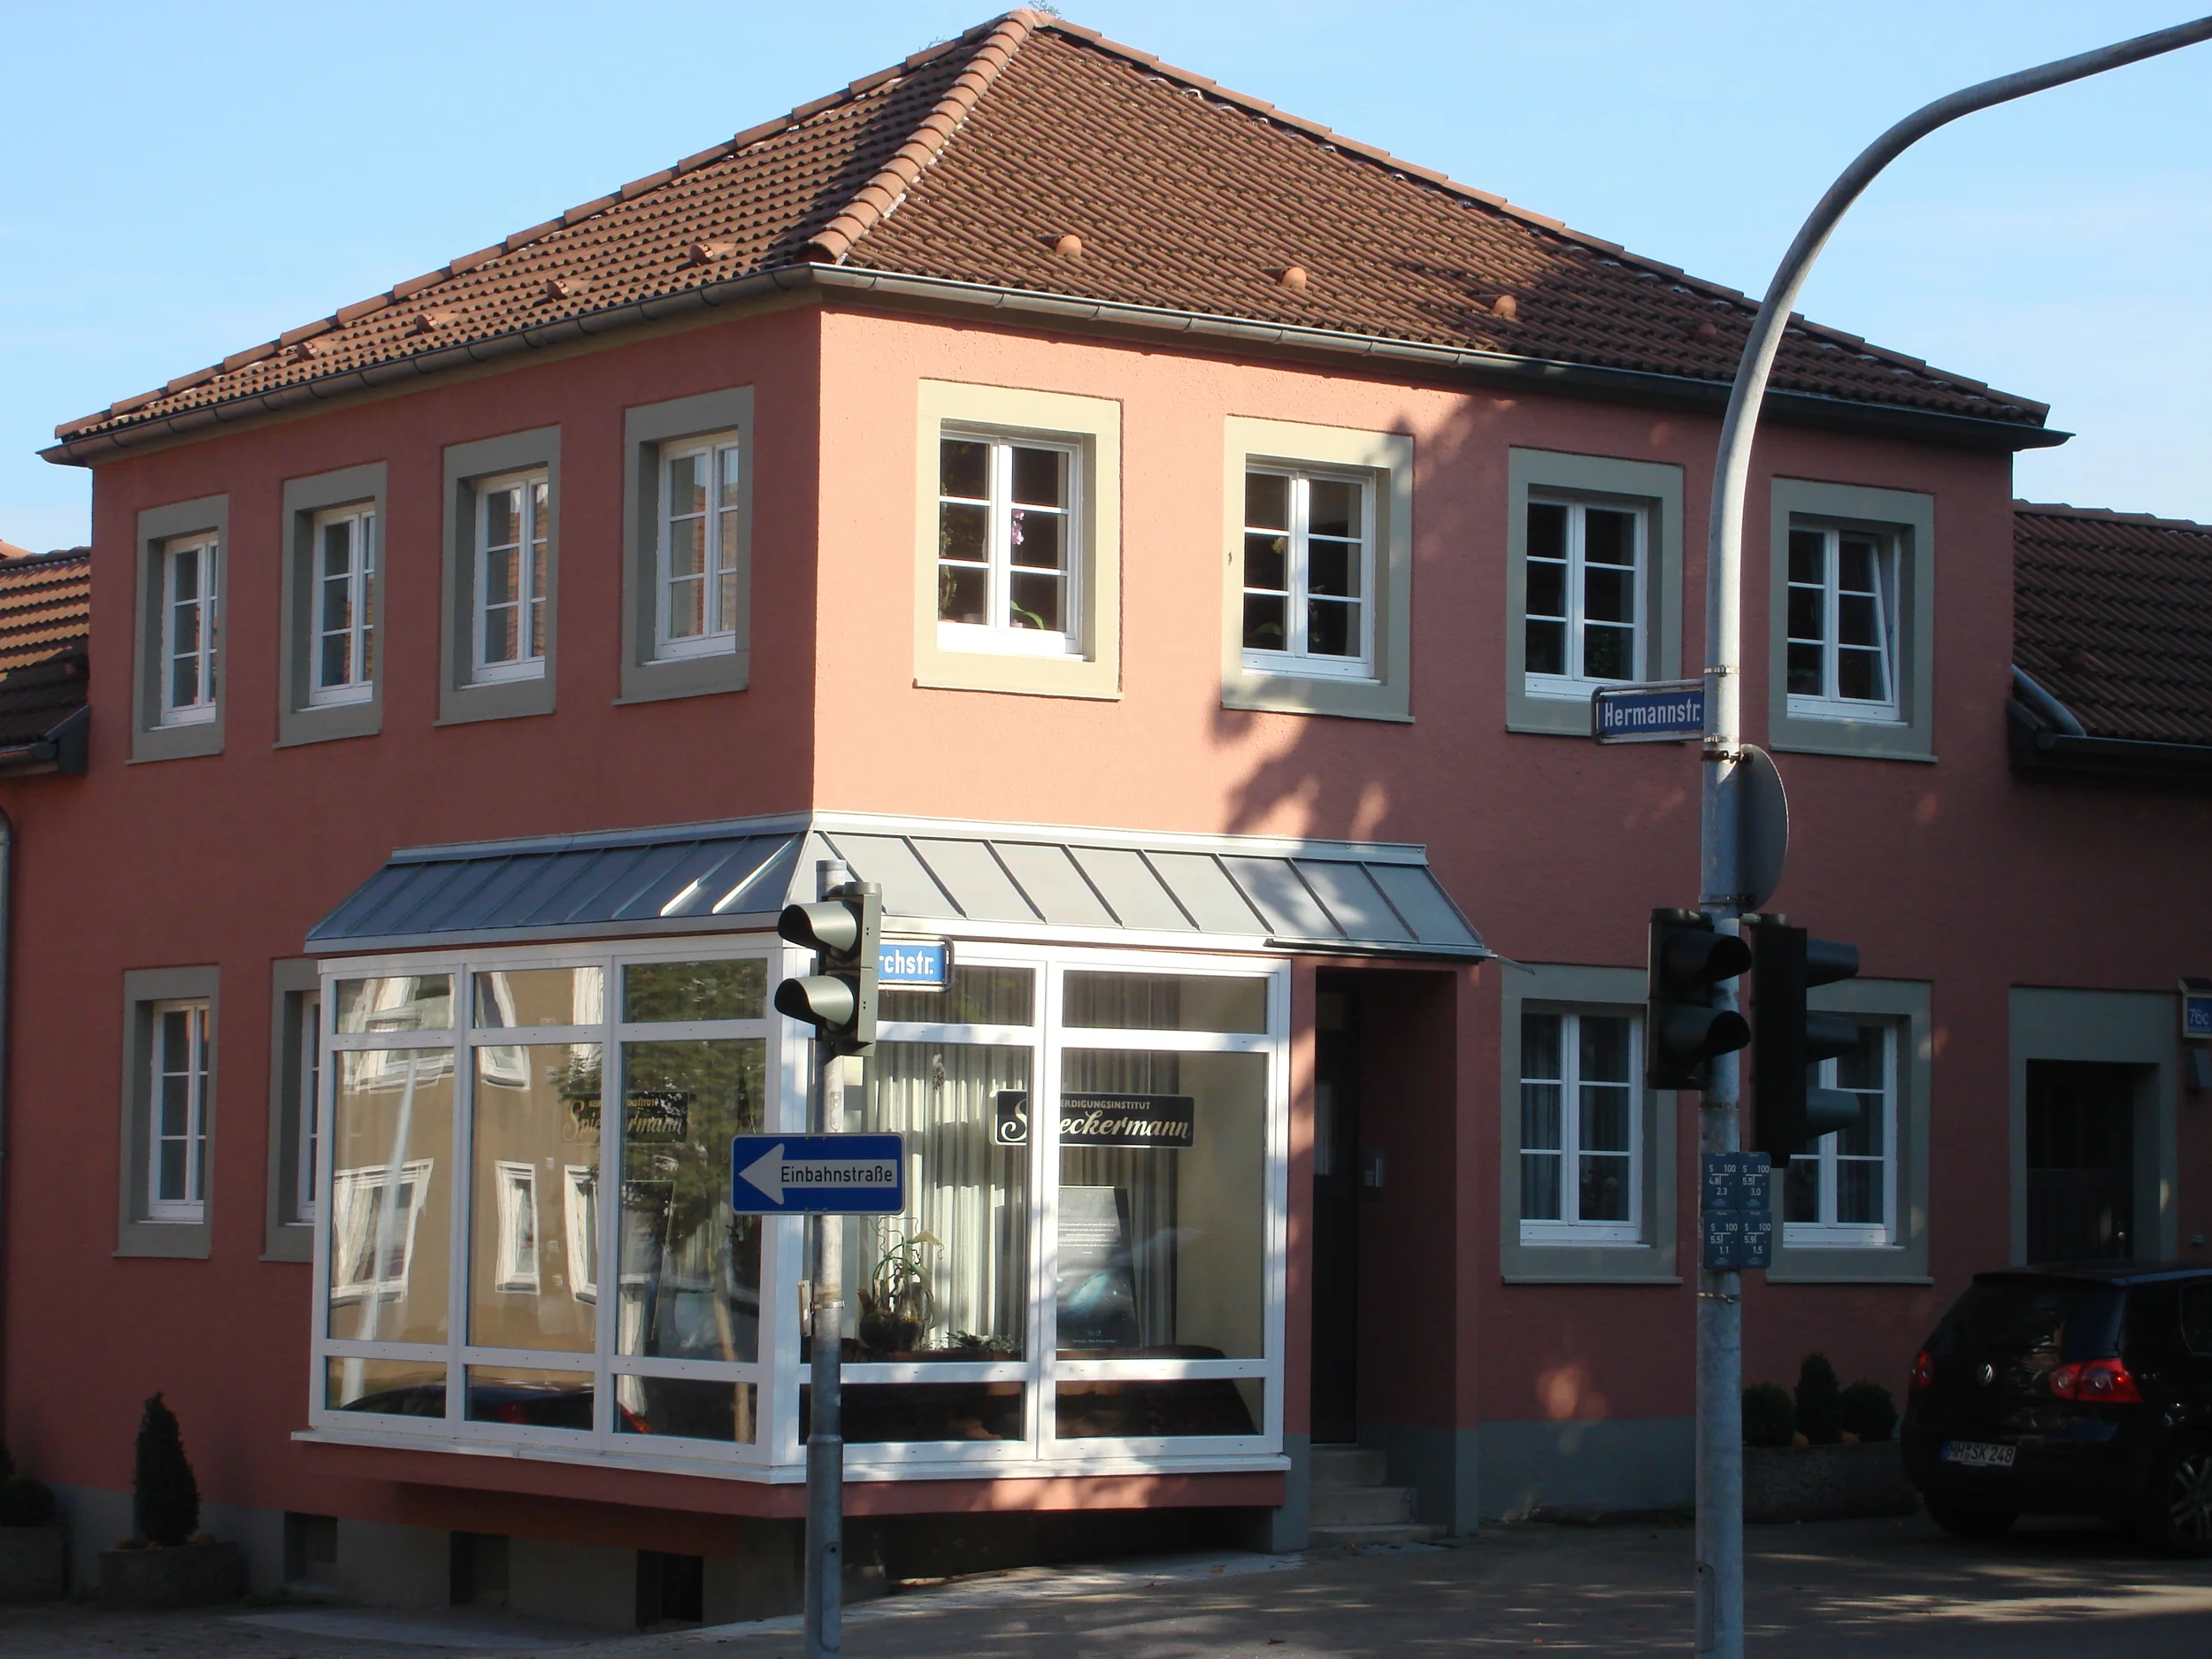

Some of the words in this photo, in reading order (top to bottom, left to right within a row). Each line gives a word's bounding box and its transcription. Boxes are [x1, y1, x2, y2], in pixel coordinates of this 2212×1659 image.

[1604, 697, 1701, 726] Hermannstr.
[879, 949, 934, 975] chstr.
[2189, 1009, 2210, 1025] 76c
[780, 1165, 893, 1183] Einbahnstraße
[1709, 1164, 1714, 1172] S
[1724, 1164, 1737, 1173] 100
[1742, 1164, 1747, 1173] S
[1757, 1164, 1770, 1173] 100
[1710, 1223, 1716, 1232] S
[1725, 1223, 1738, 1232] 100
[1744, 1223, 1749, 1232] S
[1759, 1223, 1771, 1232] 100
[1970, 1444, 1989, 1461] SK
[1988, 1446, 2014, 1463] 248
